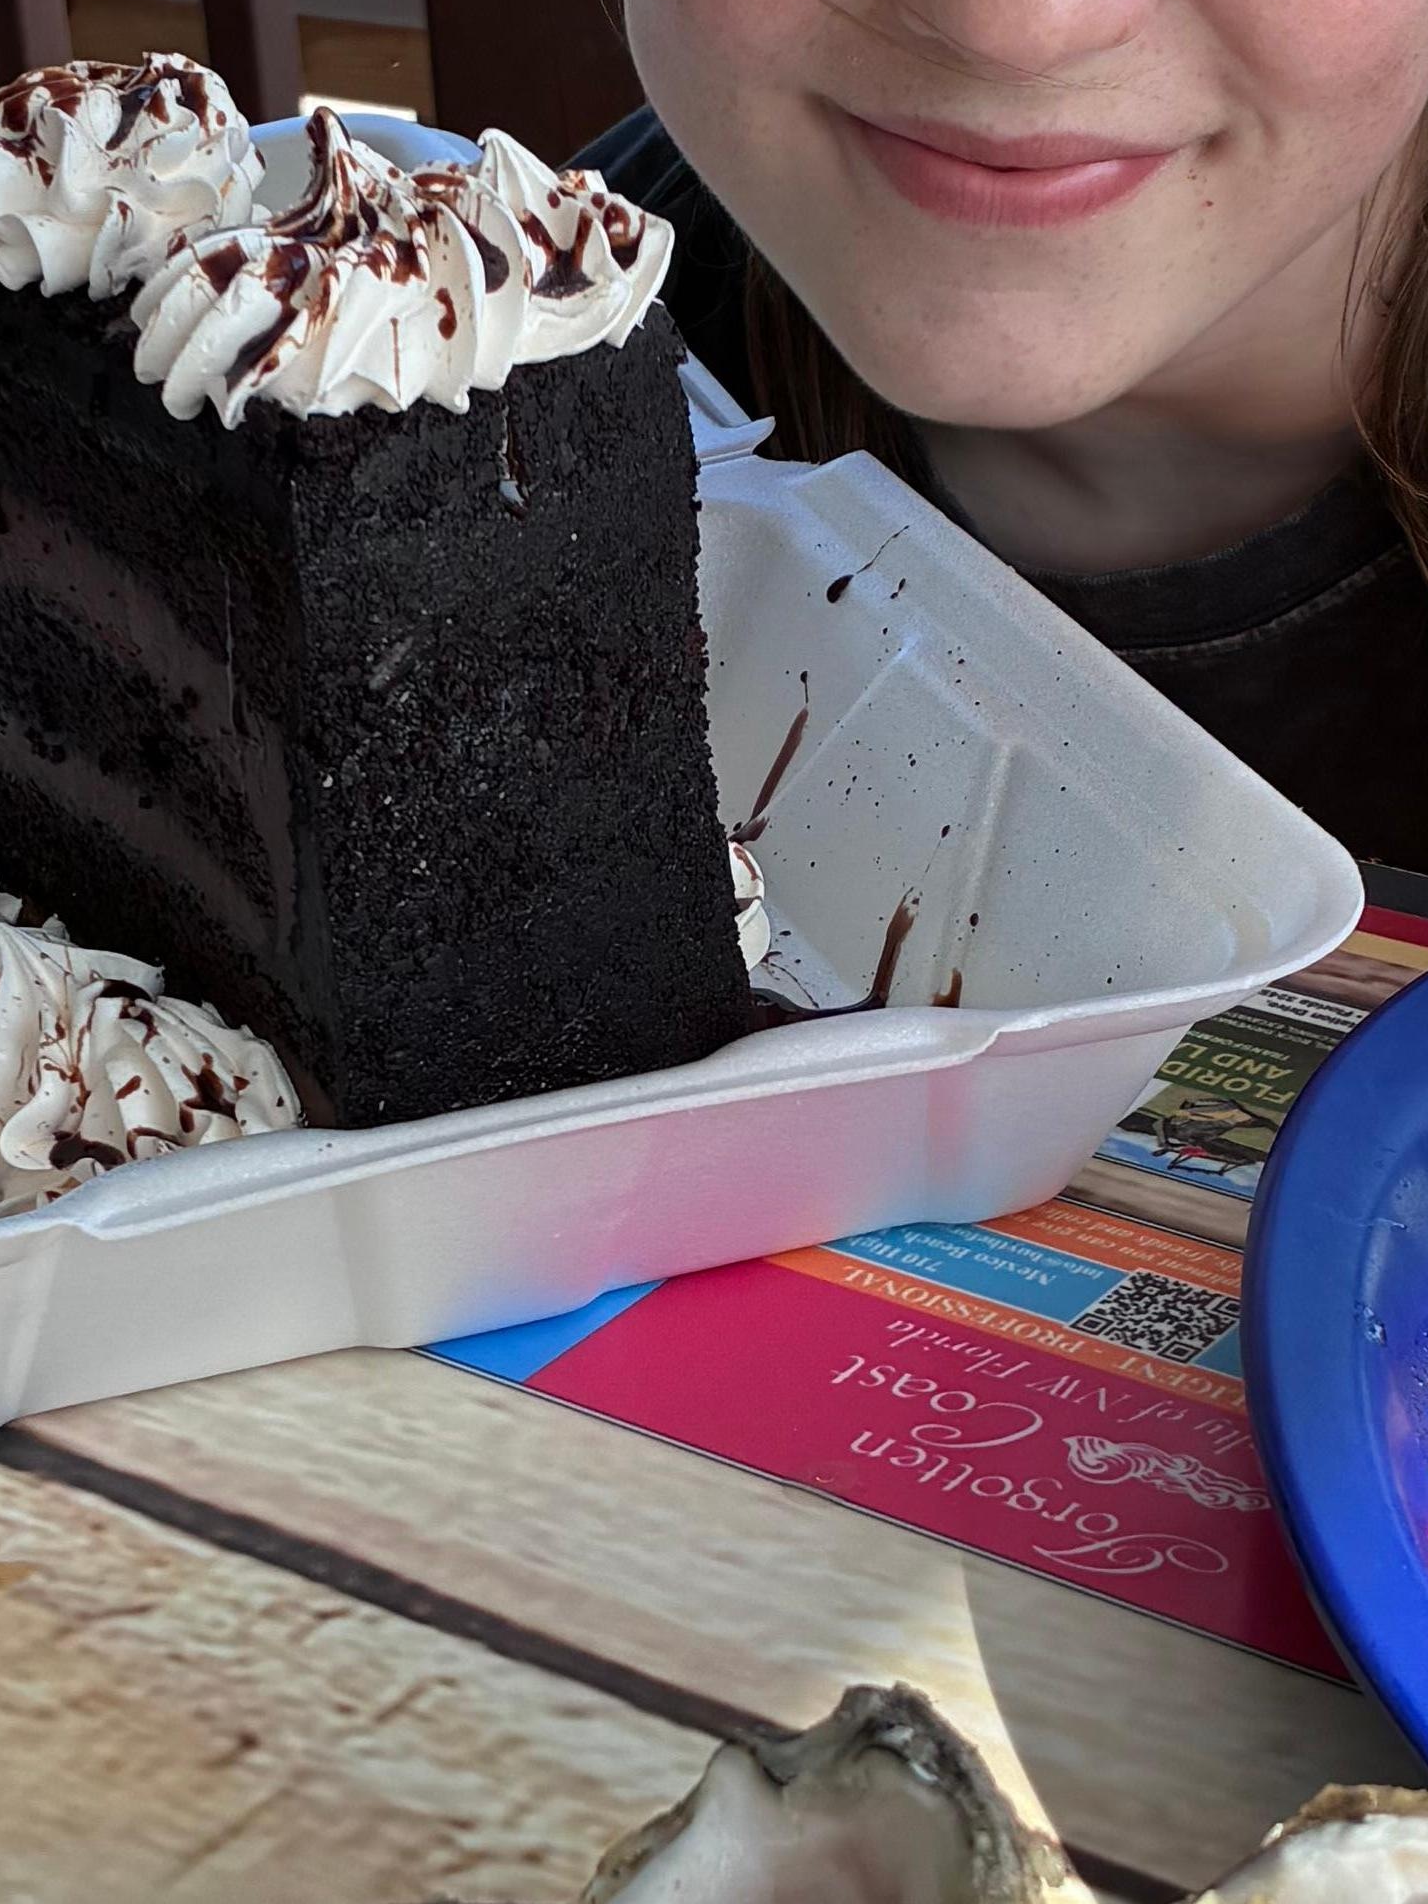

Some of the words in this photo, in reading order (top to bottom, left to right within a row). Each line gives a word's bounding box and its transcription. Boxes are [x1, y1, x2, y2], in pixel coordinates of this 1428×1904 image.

[1159, 1060, 1296, 1105] FLORID
[1210, 1053, 1295, 1080] AND
[848, 1235, 901, 1259] High
[900, 1251, 945, 1274] 710
[973, 1251, 1057, 1286] Mexico
[842, 1264, 1085, 1354] PROFESSIONAL
[885, 1319, 1031, 1379] Florida
[830, 1353, 1043, 1449] Coast
[1025, 1375, 1132, 1413] NW
[1114, 1356, 1246, 1407] LIGENT
[849, 1429, 1229, 1574] Forgotten
